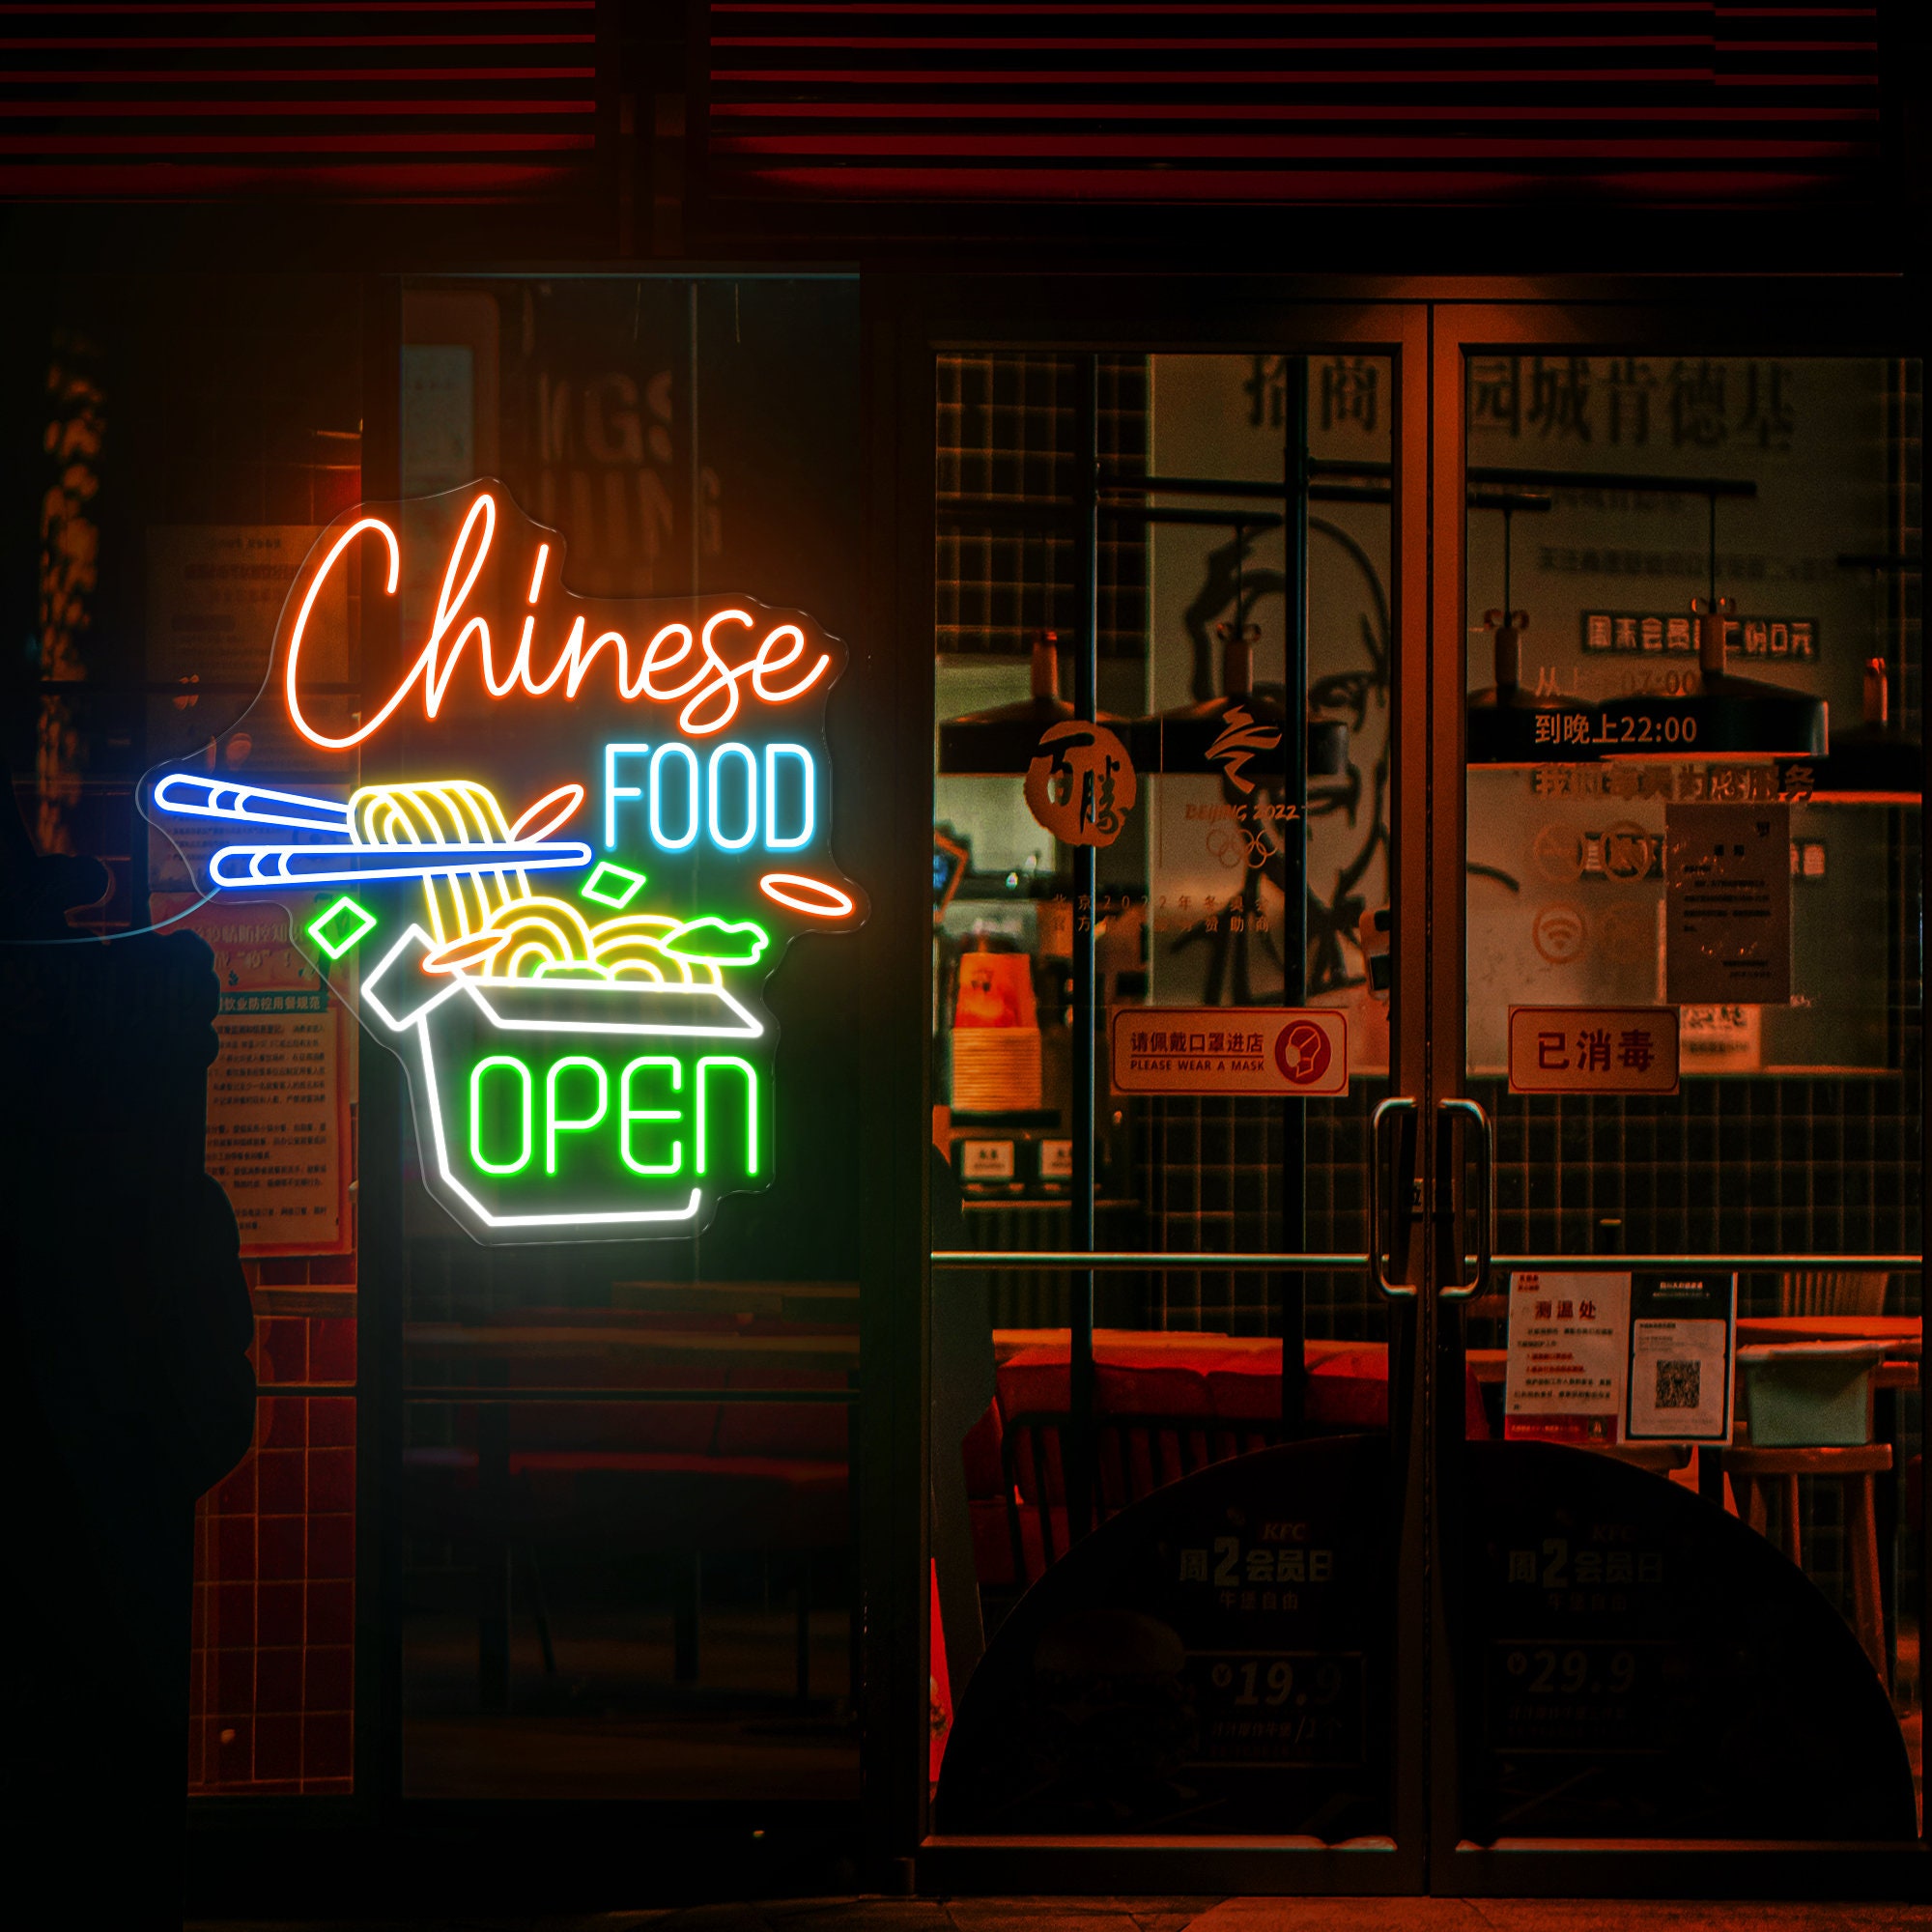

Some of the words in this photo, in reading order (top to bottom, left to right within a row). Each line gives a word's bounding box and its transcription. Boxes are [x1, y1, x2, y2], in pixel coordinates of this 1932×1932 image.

[283, 493, 831, 750] Chinese
[1534, 712, 1698, 745] 到晚上22:00
[604, 742, 817, 851] FOOD
[1252, 804, 1301, 821] 2022
[1130, 1031, 1264, 1053] 请佩戴口罩进店
[1538, 1029, 1655, 1071] 已消毒
[1130, 1059, 1173, 1071] PLEASE
[1178, 1059, 1211, 1071] WEAR
[1217, 1059, 1226, 1071] A
[1231, 1059, 1264, 1071] MASK
[469, 1055, 758, 1177] OPEN
[1535, 1300, 1597, 1321] 测温处
[1262, 1522, 1307, 1542] KFC
[1590, 1523, 1636, 1543] KFC
[1178, 1536, 1336, 1588] 周2会员日
[1506, 1536, 1665, 1589] 周2会员日
